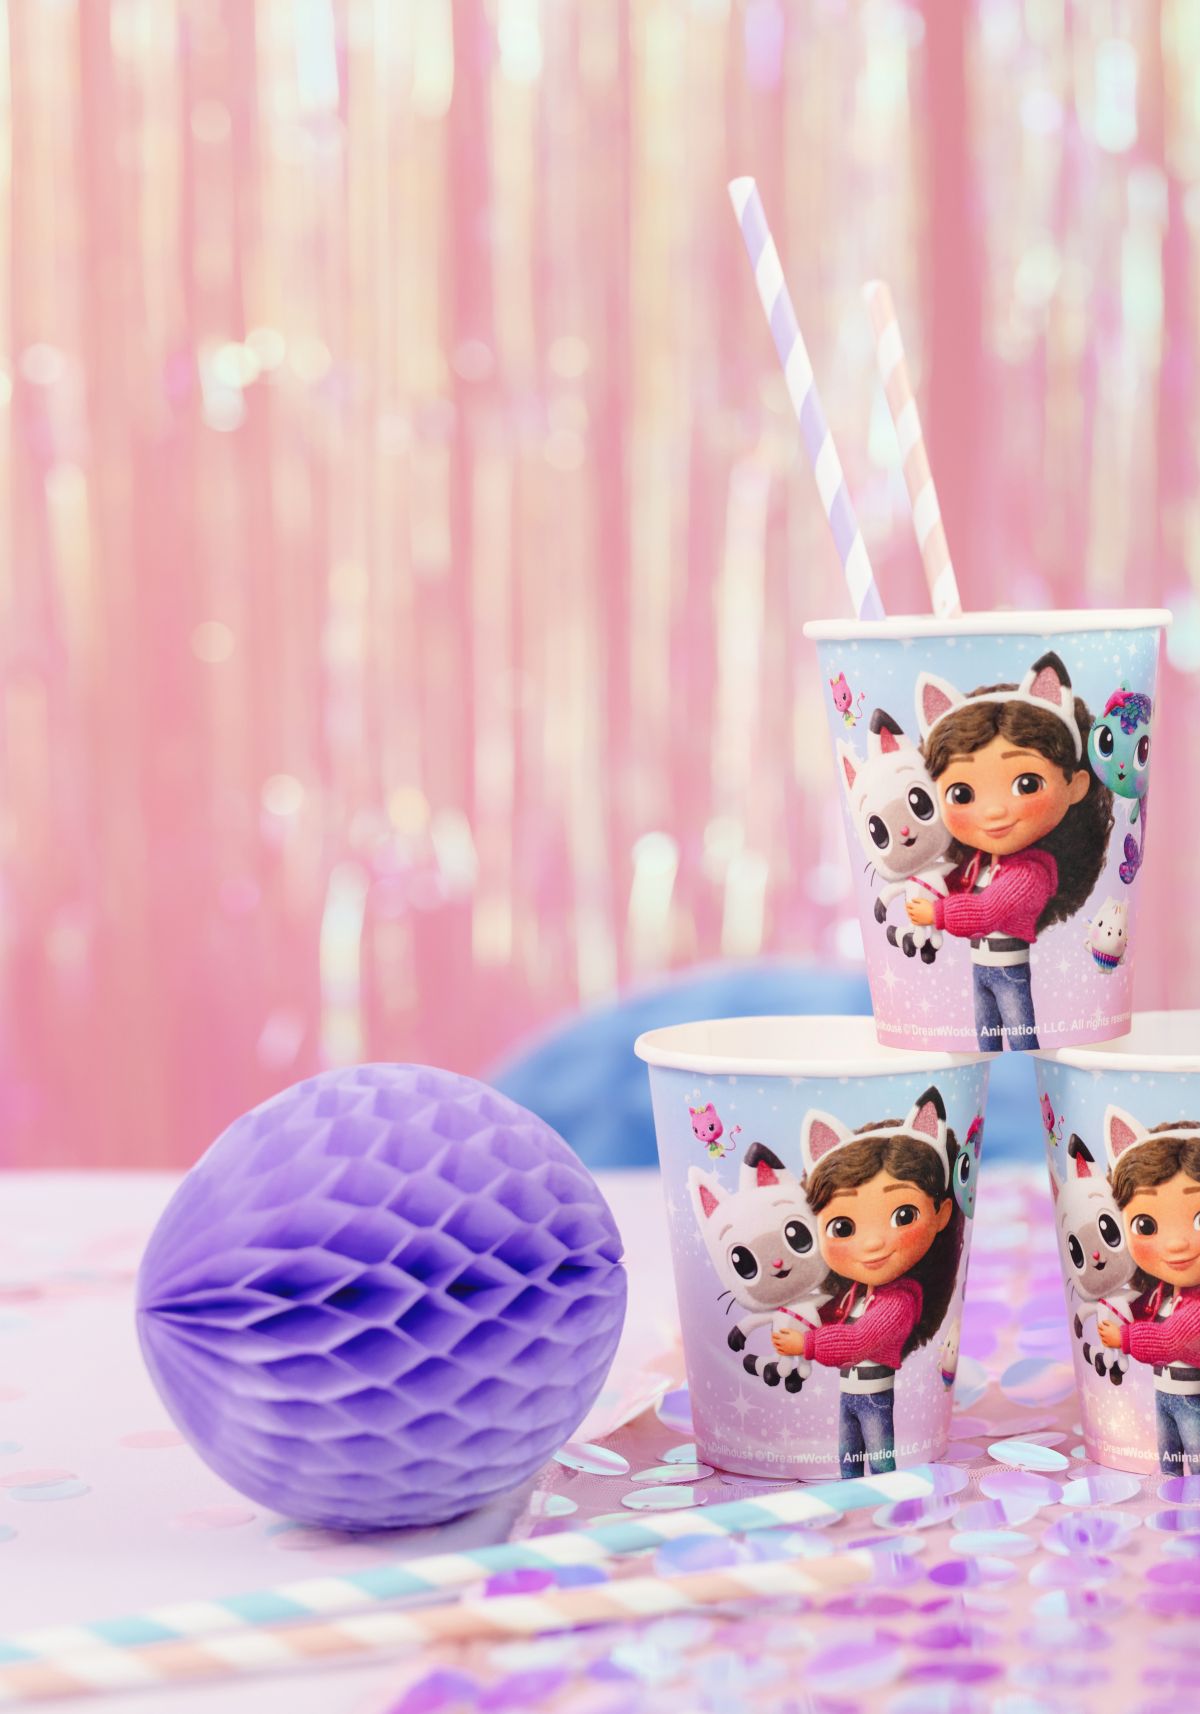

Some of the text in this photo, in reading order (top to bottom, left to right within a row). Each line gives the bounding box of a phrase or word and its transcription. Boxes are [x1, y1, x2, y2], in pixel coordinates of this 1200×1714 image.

[911, 1024, 978, 1037] DreamWorks
[980, 1024, 1040, 1037] Animation
[1043, 1021, 1069, 1034] LLC.
[1070, 1018, 1084, 1031] All
[1086, 1014, 1110, 1032] rights
[767, 1451, 839, 1464] DreamWorks
[842, 1448, 898, 1464] Animation
[922, 1438, 932, 1450] All
[1103, 1440, 1159, 1461] DreamWorks
